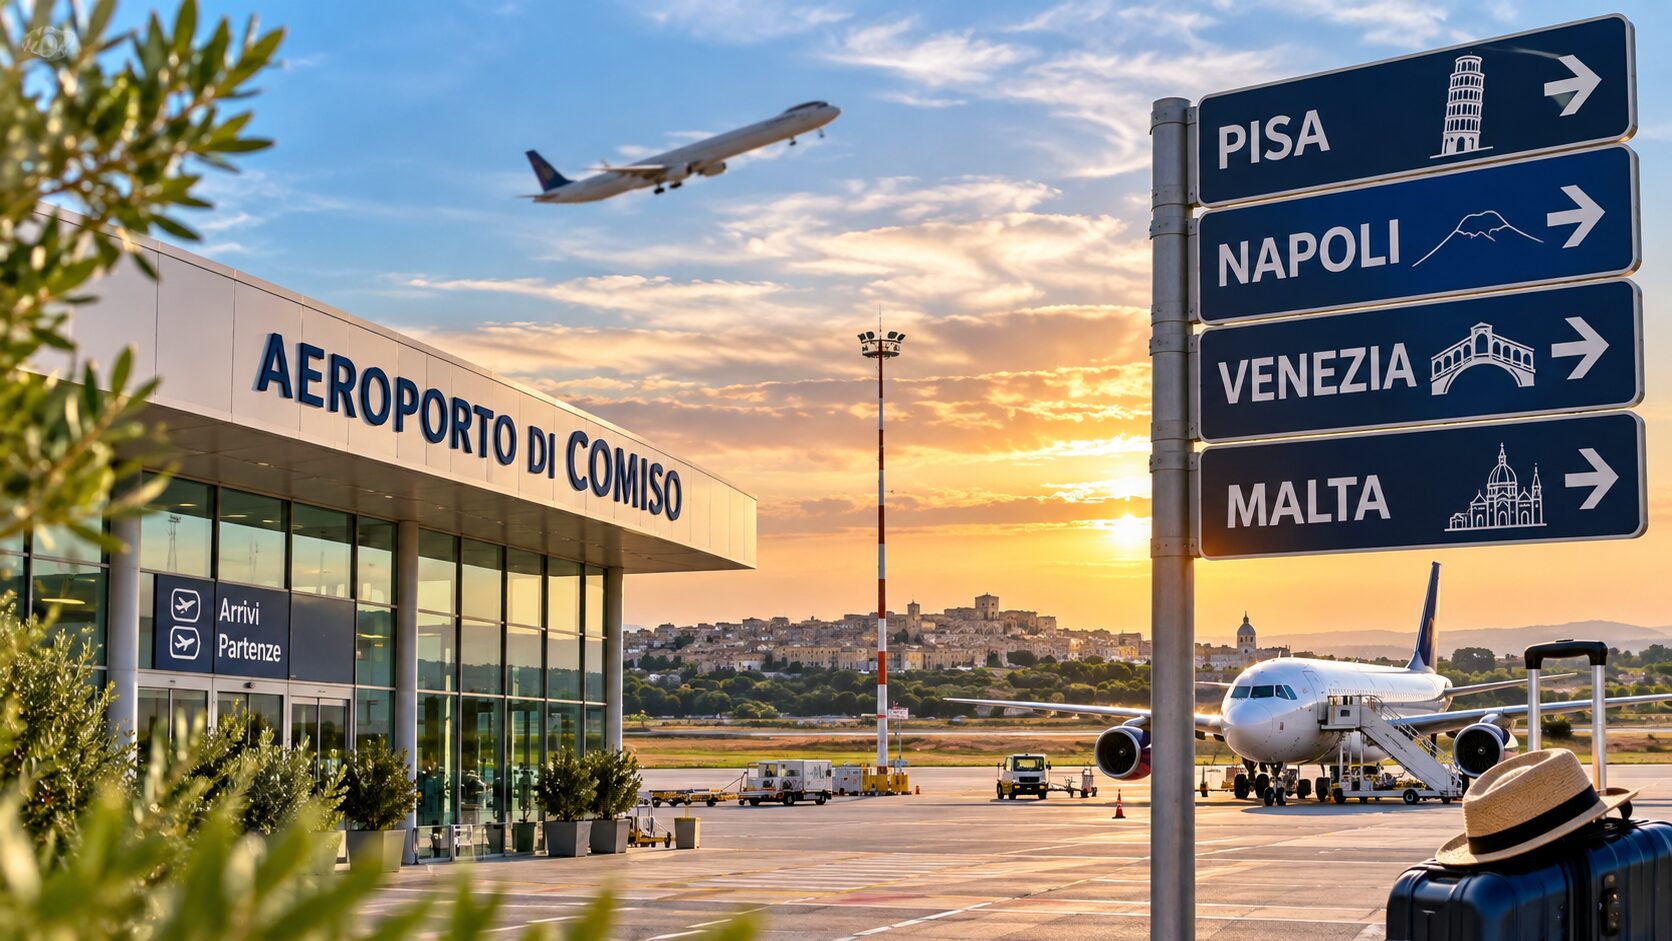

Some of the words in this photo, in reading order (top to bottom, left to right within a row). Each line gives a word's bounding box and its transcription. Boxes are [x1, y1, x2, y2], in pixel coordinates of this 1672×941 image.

[1219, 109, 1330, 170] PISA
[1218, 219, 1400, 287] NAPOLI
[1218, 343, 1417, 404] VENEZIA
[255, 333, 517, 465] AEROPORTO
[528, 426, 555, 479] DI
[566, 431, 683, 521] COMISO
[1227, 475, 1391, 528] MALTA
[219, 598, 260, 626] Arrivi
[218, 633, 282, 663] Partenze
